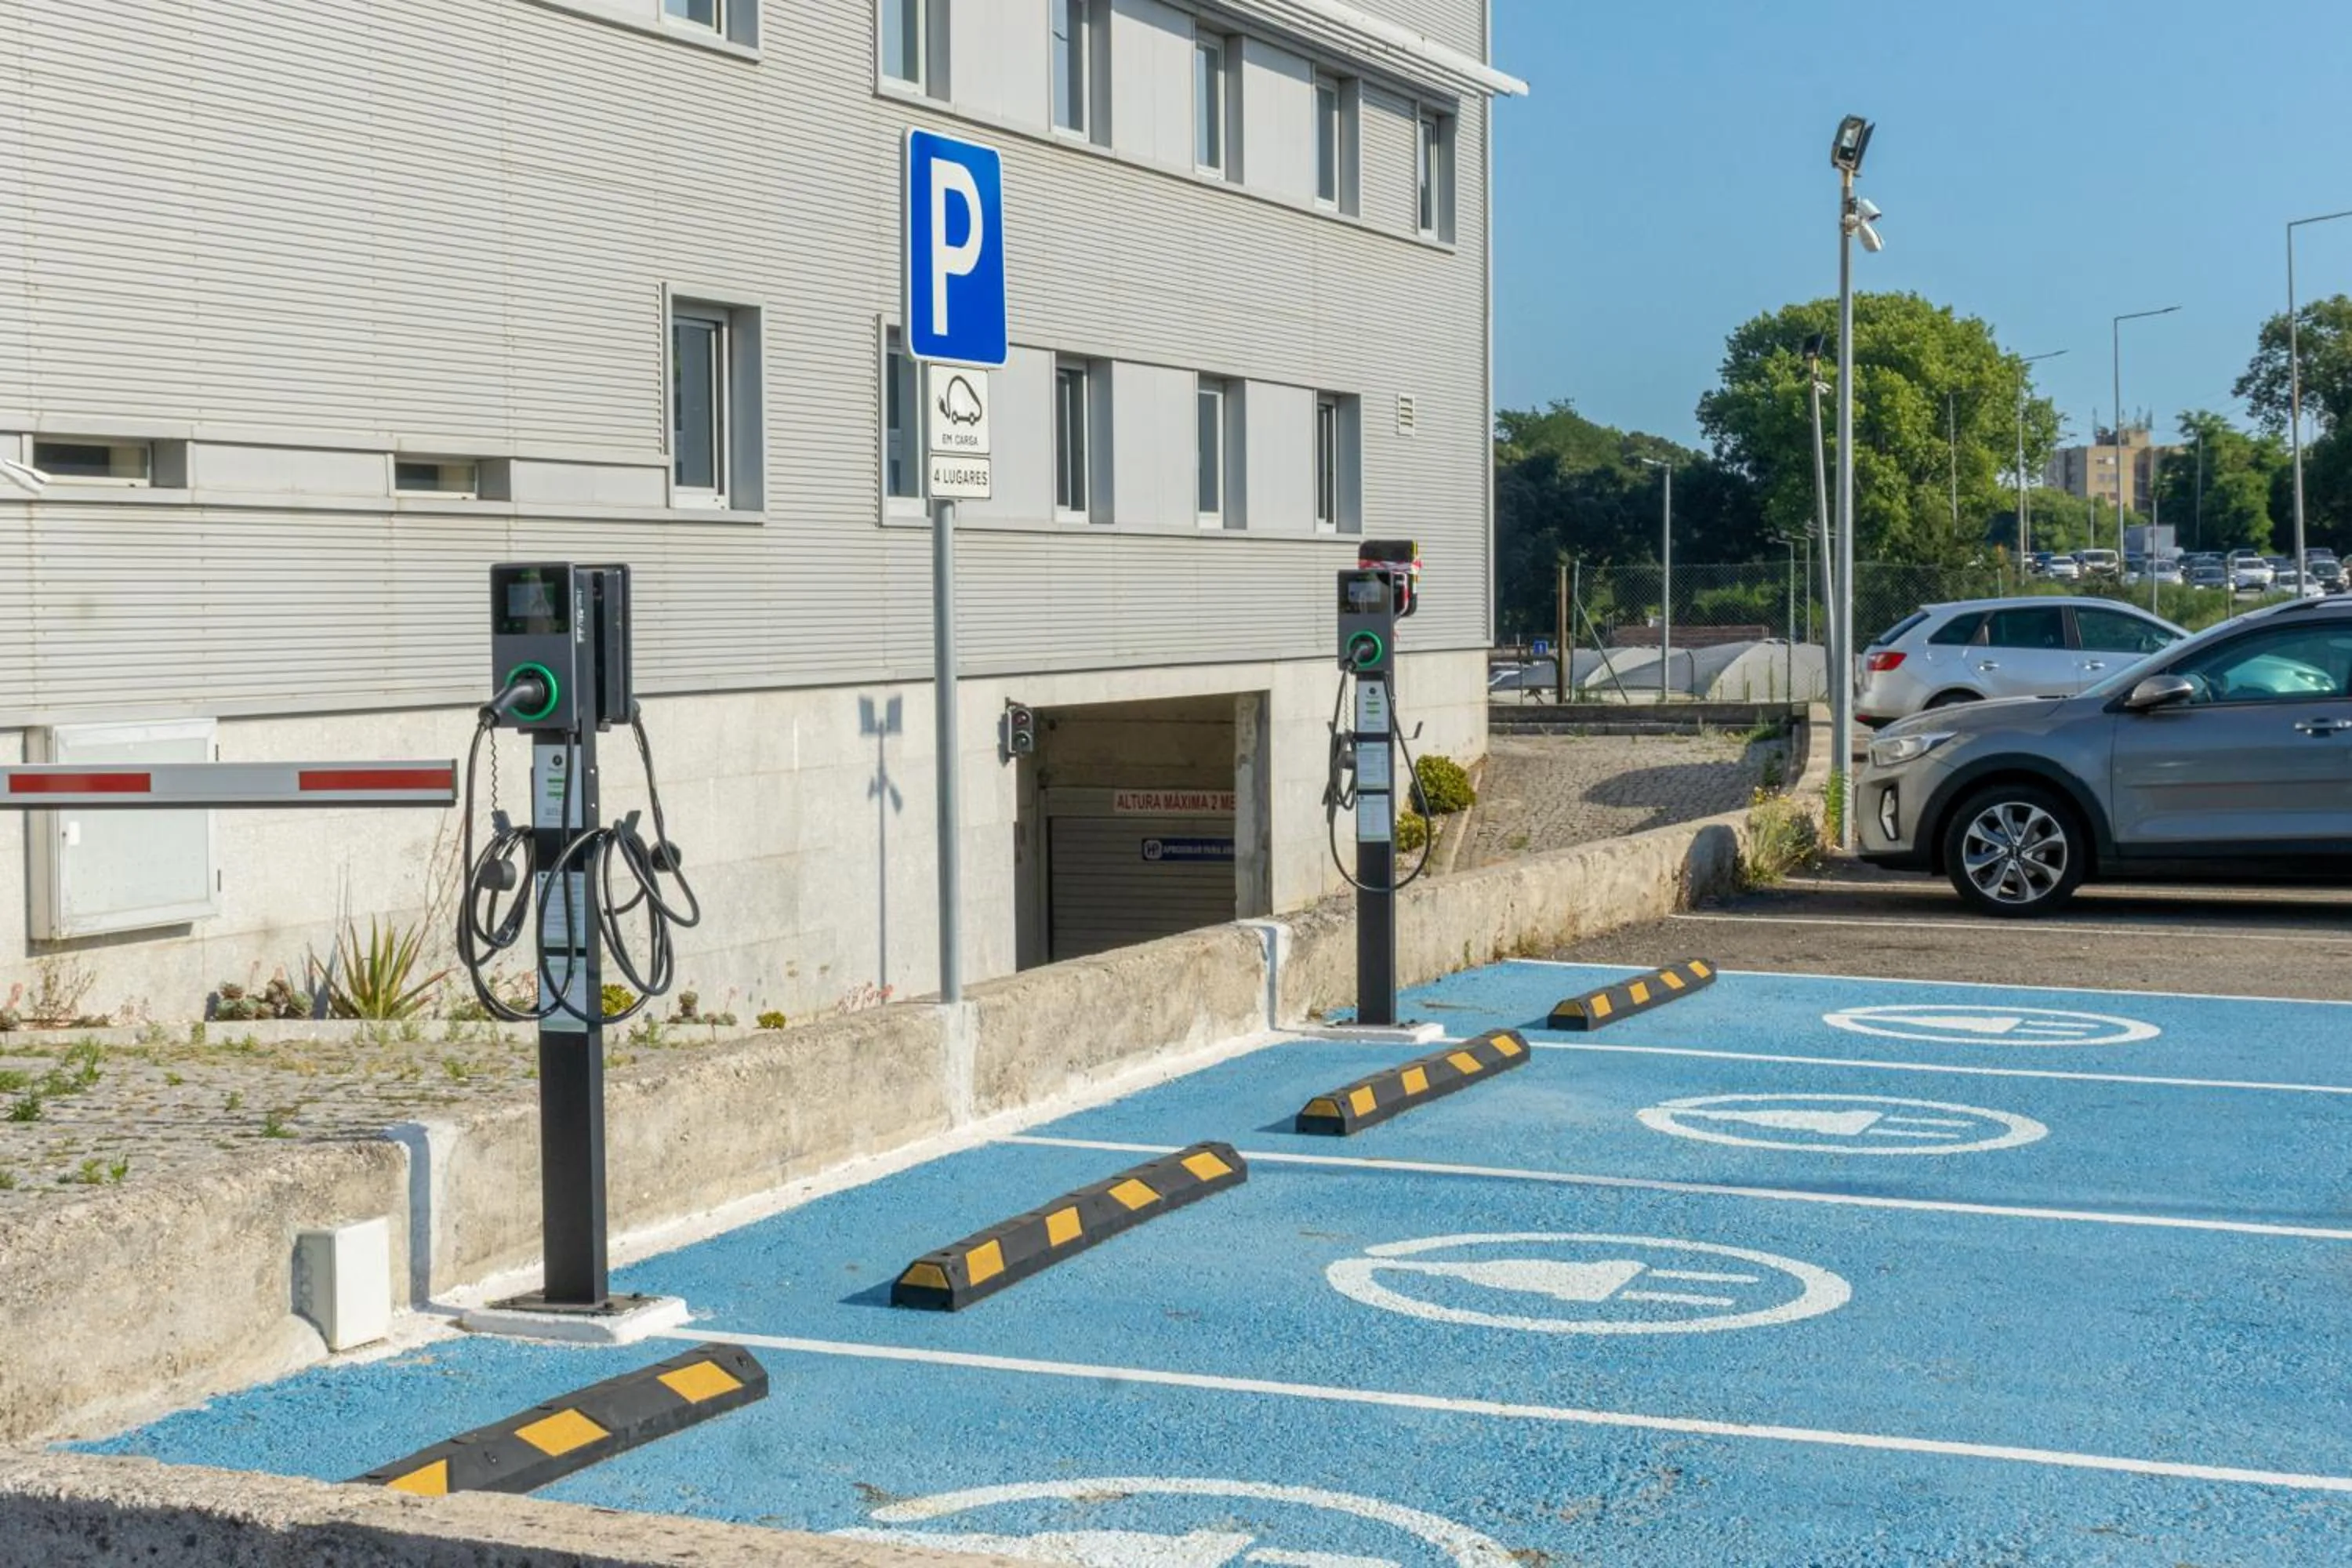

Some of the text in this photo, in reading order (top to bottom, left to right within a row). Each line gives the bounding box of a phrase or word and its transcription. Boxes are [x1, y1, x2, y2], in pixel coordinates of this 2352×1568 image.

[931, 157, 983, 336] P
[942, 433, 978, 446] EM CARGA
[934, 468, 988, 485] 4 LUGARES
[1116, 793, 1160, 810] ALTURA
[1210, 794, 1217, 810] 2
